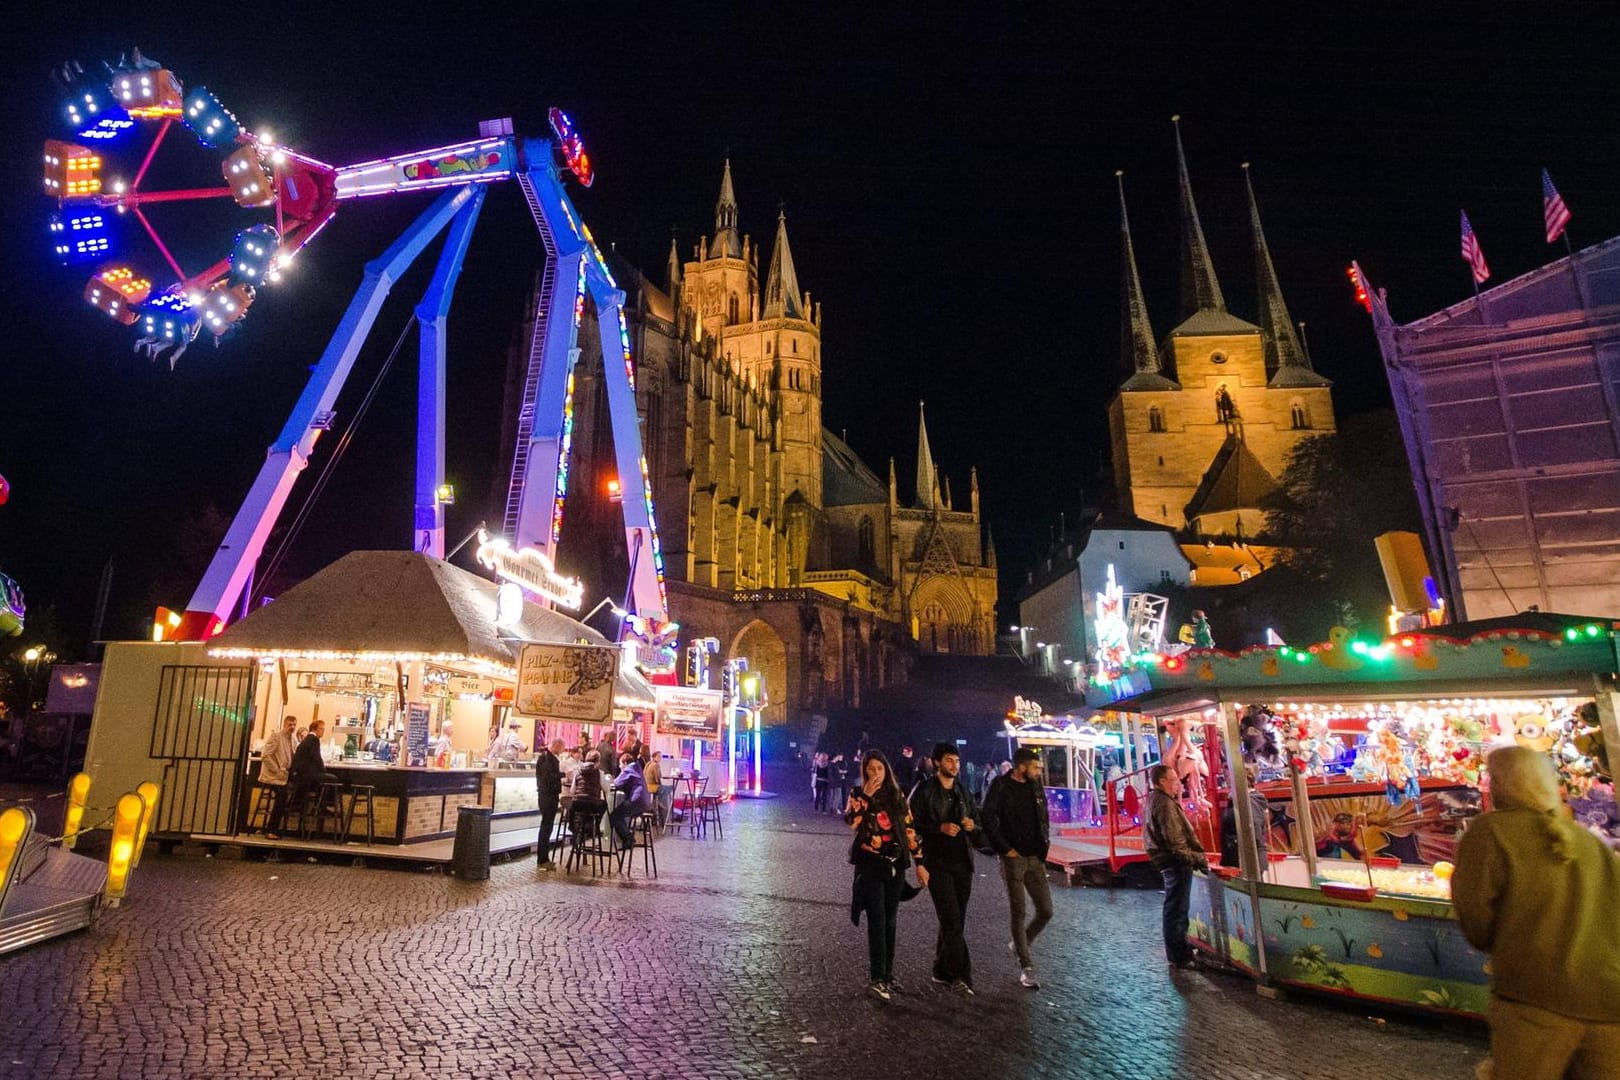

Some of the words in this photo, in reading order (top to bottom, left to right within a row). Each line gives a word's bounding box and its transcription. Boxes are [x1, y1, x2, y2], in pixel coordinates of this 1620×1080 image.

[525, 654, 559, 668] PILZ-
[523, 669, 573, 685] PFANNE
[461, 680, 480, 690] Bier
